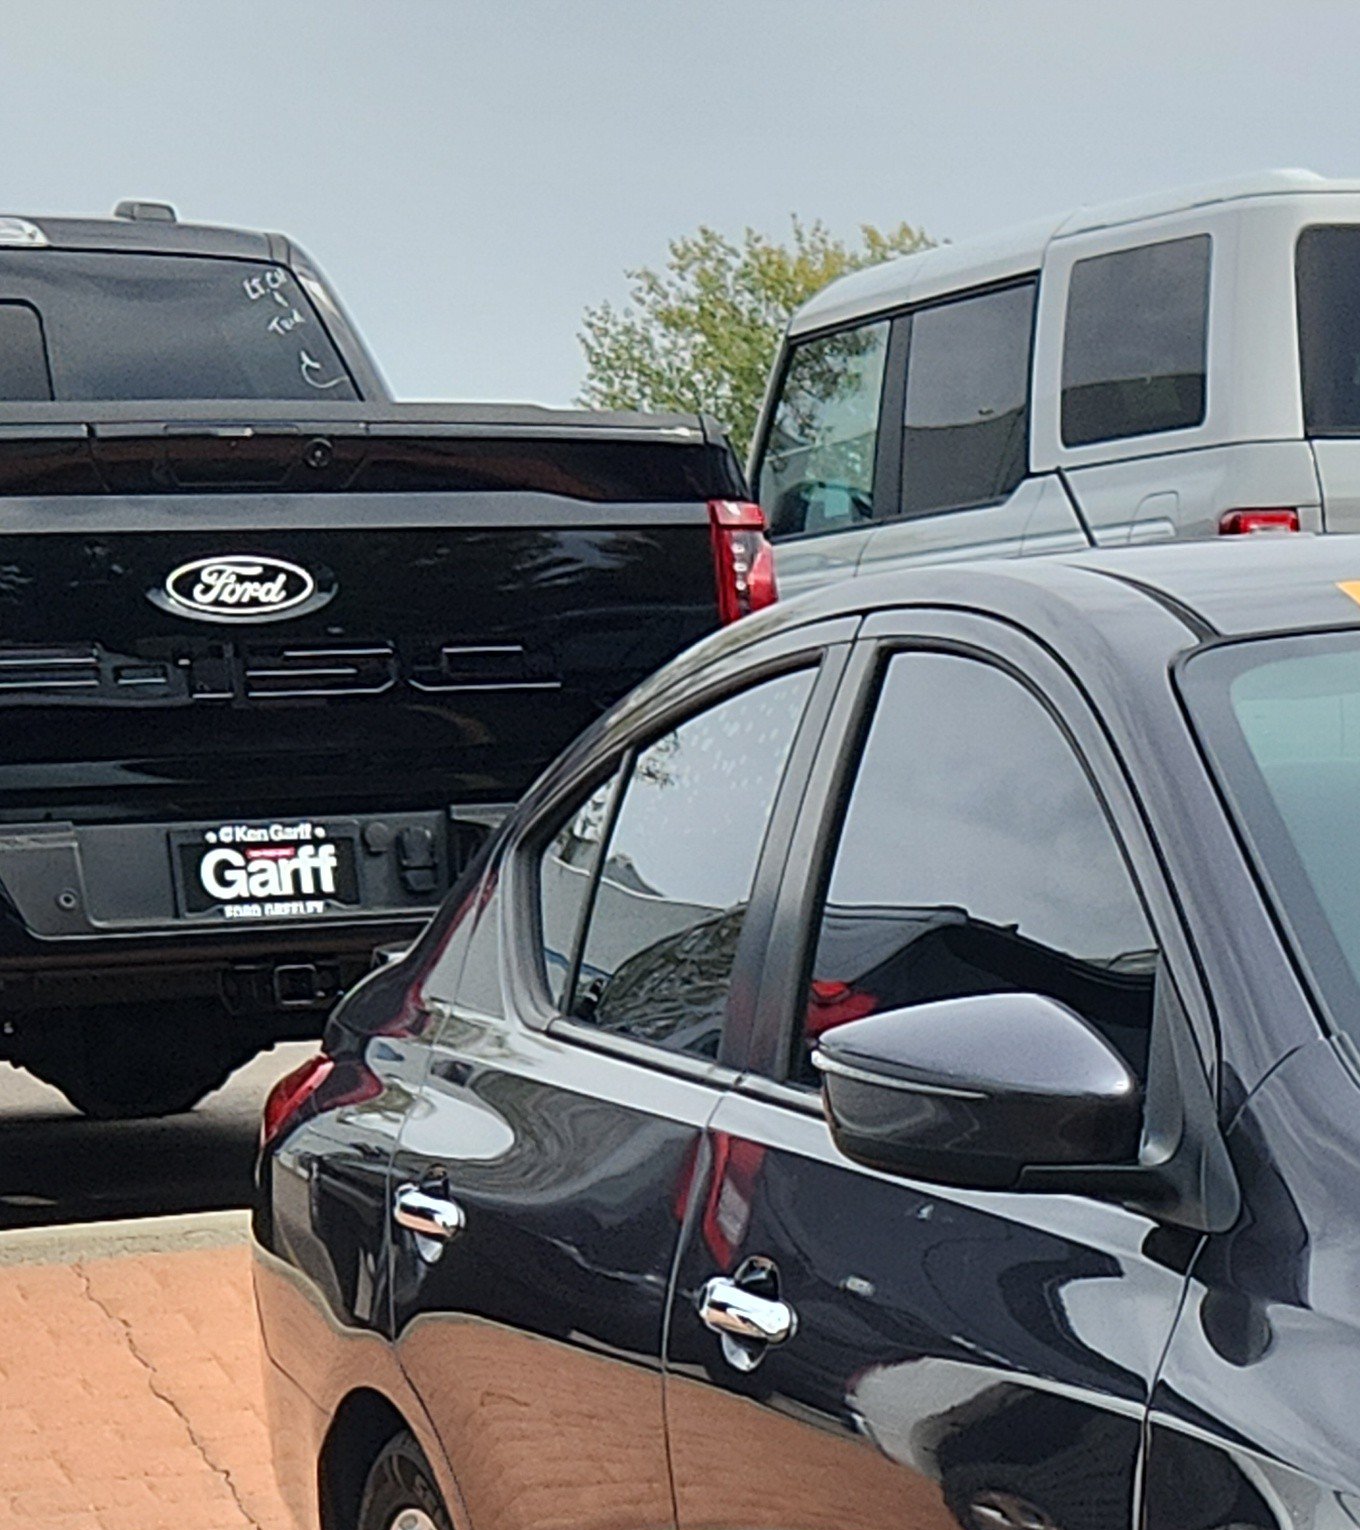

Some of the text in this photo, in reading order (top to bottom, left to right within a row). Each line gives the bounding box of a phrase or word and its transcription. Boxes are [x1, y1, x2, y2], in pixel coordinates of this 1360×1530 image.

[193, 565, 287, 604] Ford
[235, 823, 312, 841] Ken Garff
[201, 844, 337, 899] Garff
